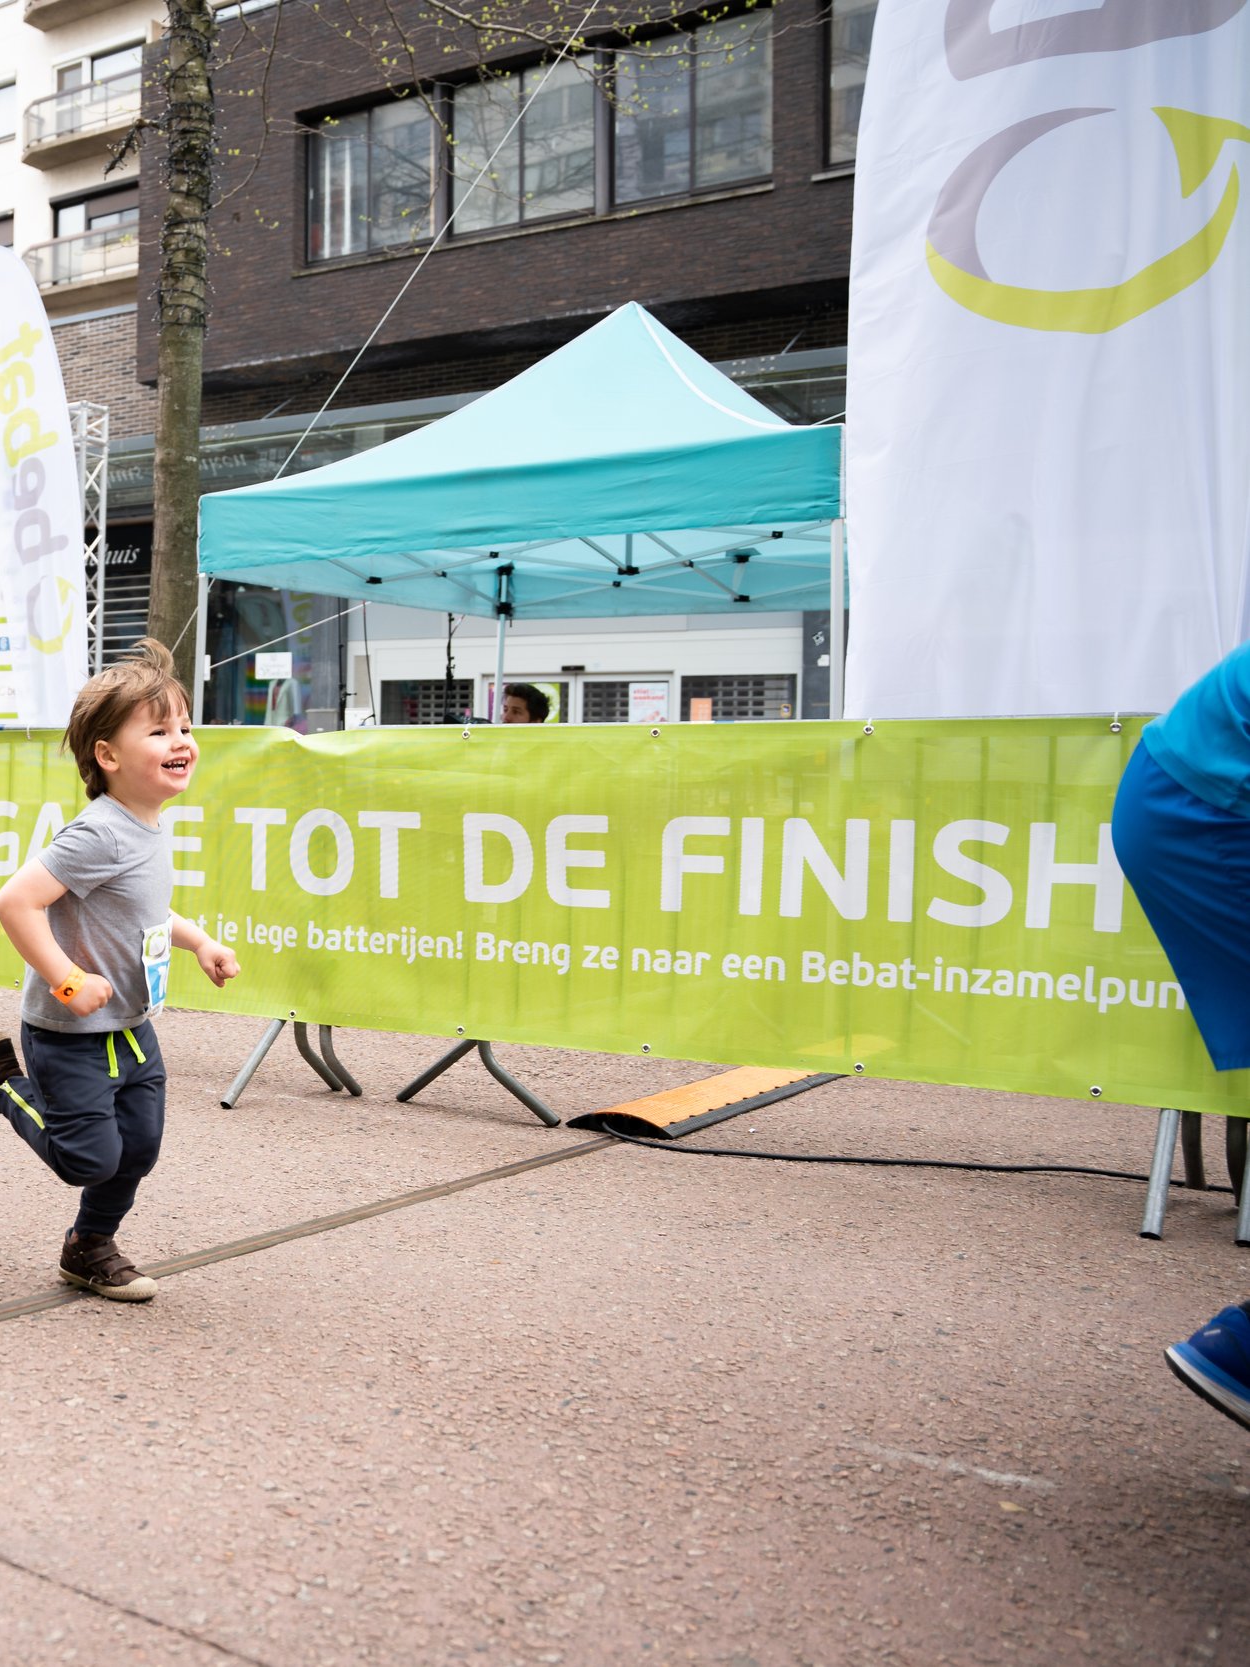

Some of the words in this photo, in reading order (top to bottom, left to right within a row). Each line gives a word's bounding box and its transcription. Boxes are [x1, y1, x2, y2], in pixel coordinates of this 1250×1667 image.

[234, 807, 421, 899] TOT
[463, 812, 611, 909] DE
[659, 815, 1124, 933] FINISH
[216, 914, 238, 944] je
[246, 916, 298, 954] lege
[307, 920, 463, 964] batterijen!
[475, 931, 571, 974] Breng
[582, 945, 619, 970] ze
[632, 947, 712, 975] naar
[722, 953, 786, 981] een
[802, 951, 1186, 1014] Bebat-inzamelpun
